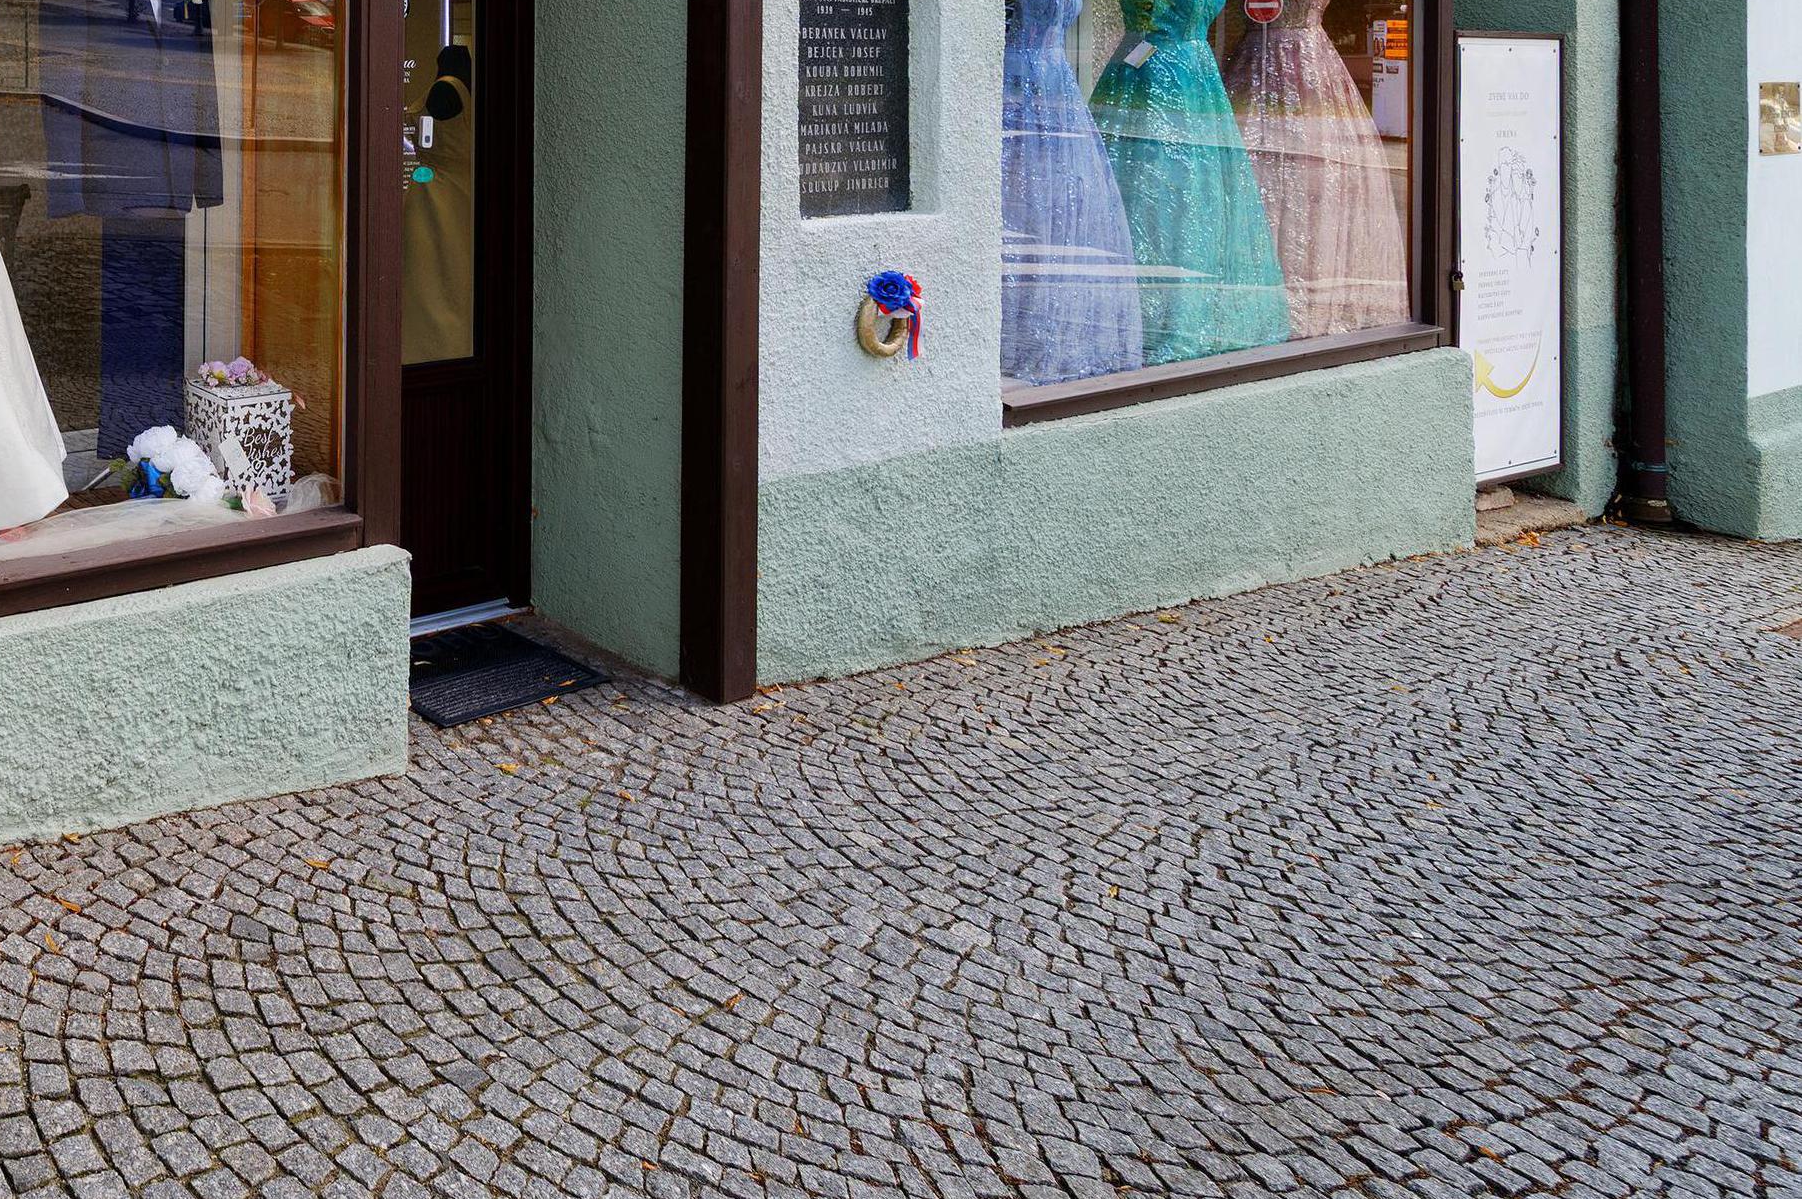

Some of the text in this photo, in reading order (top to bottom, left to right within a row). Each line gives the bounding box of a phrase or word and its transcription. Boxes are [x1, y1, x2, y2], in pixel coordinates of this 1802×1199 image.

[816, 5, 833, 15] 1939
[857, 6, 873, 16] 1945
[802, 23, 887, 40] BERÁNEK VÁCLAV
[807, 42, 882, 58] BEJČEK JOSEF
[806, 65, 885, 78] KOUBA BOHUMIL
[805, 83, 884, 97] KREJZA ROBERT
[812, 104, 838, 116] KUNA
[800, 119, 889, 136] MAŘÍKOVÁ MILADA
[849, 136, 885, 152] VÁCLAV
[802, 180, 839, 194] SOUKUP
[244, 426, 273, 447] Best
